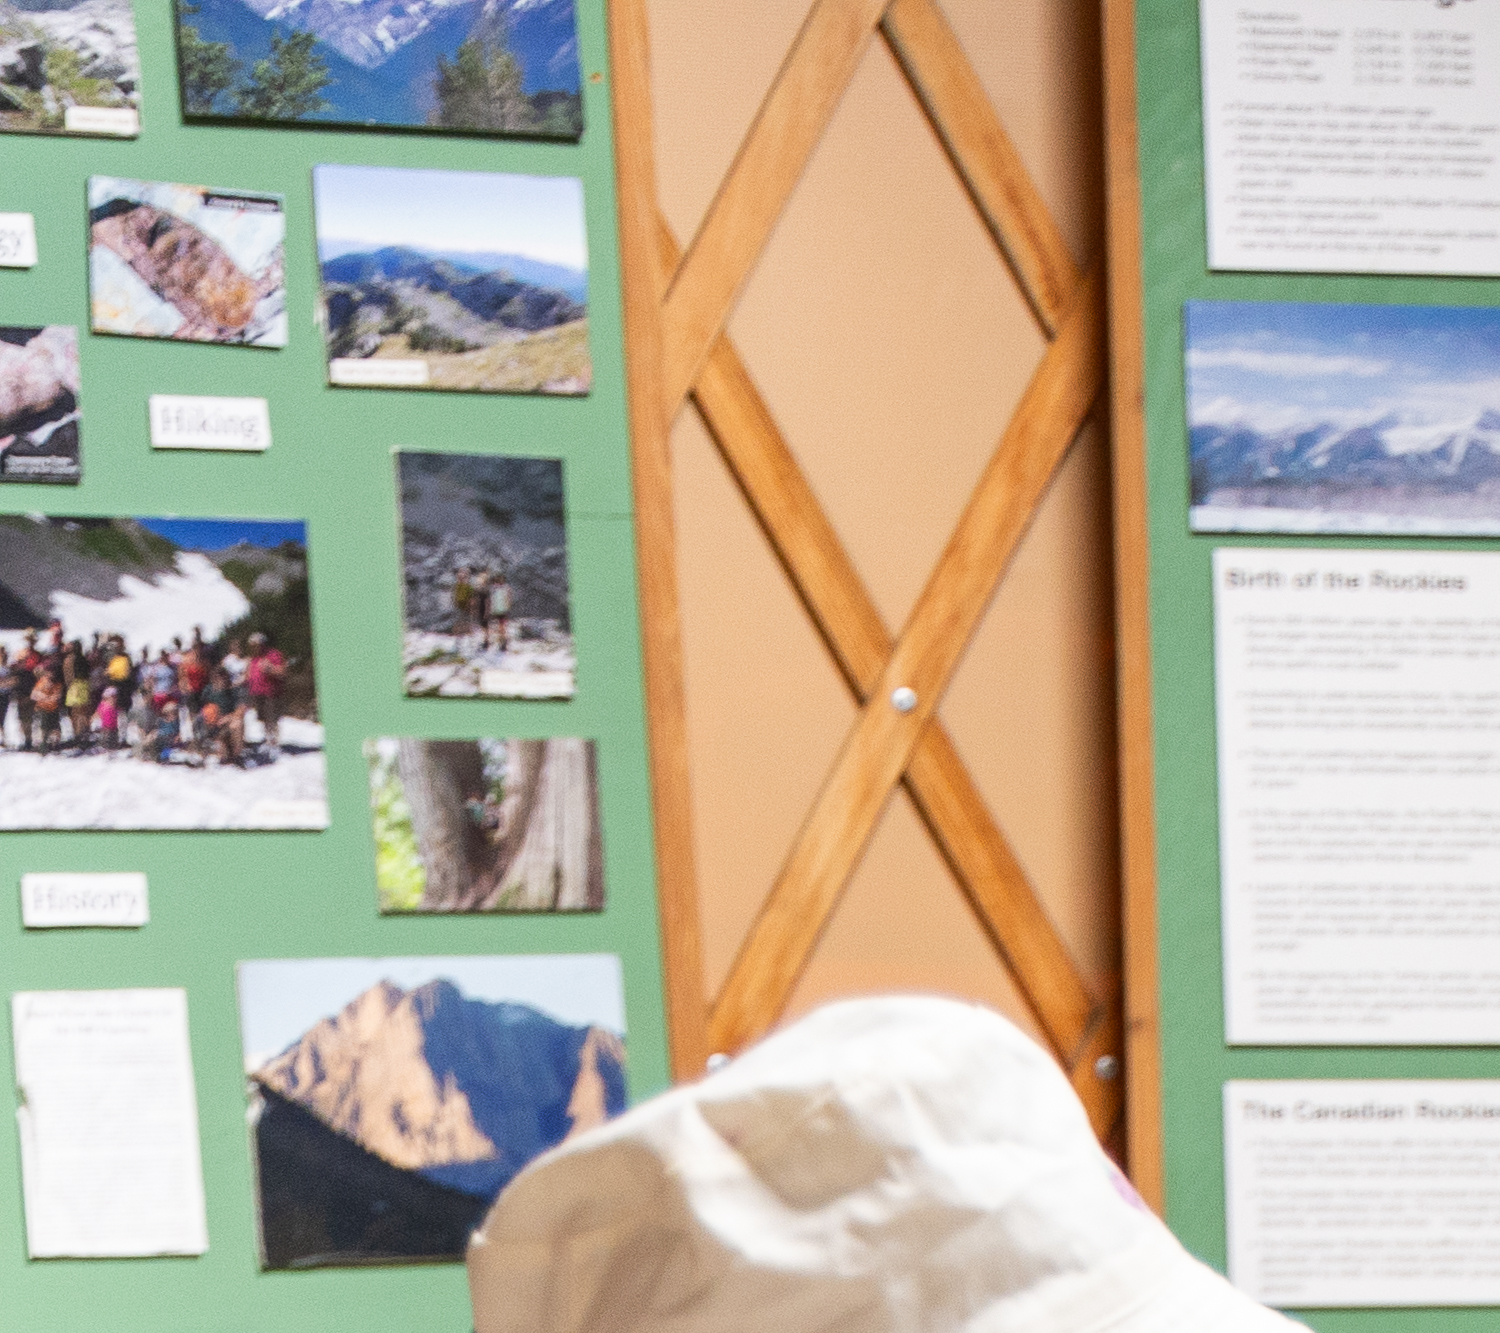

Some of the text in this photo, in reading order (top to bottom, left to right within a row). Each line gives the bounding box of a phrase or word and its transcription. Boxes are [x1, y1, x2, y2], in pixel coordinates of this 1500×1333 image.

[160, 405, 261, 443] Hiking
[1224, 568, 1467, 591] Birth of the Rockies
[33, 882, 140, 919] History
[1242, 1099, 1286, 1121] The
[1293, 1099, 1406, 1121] Canadian
